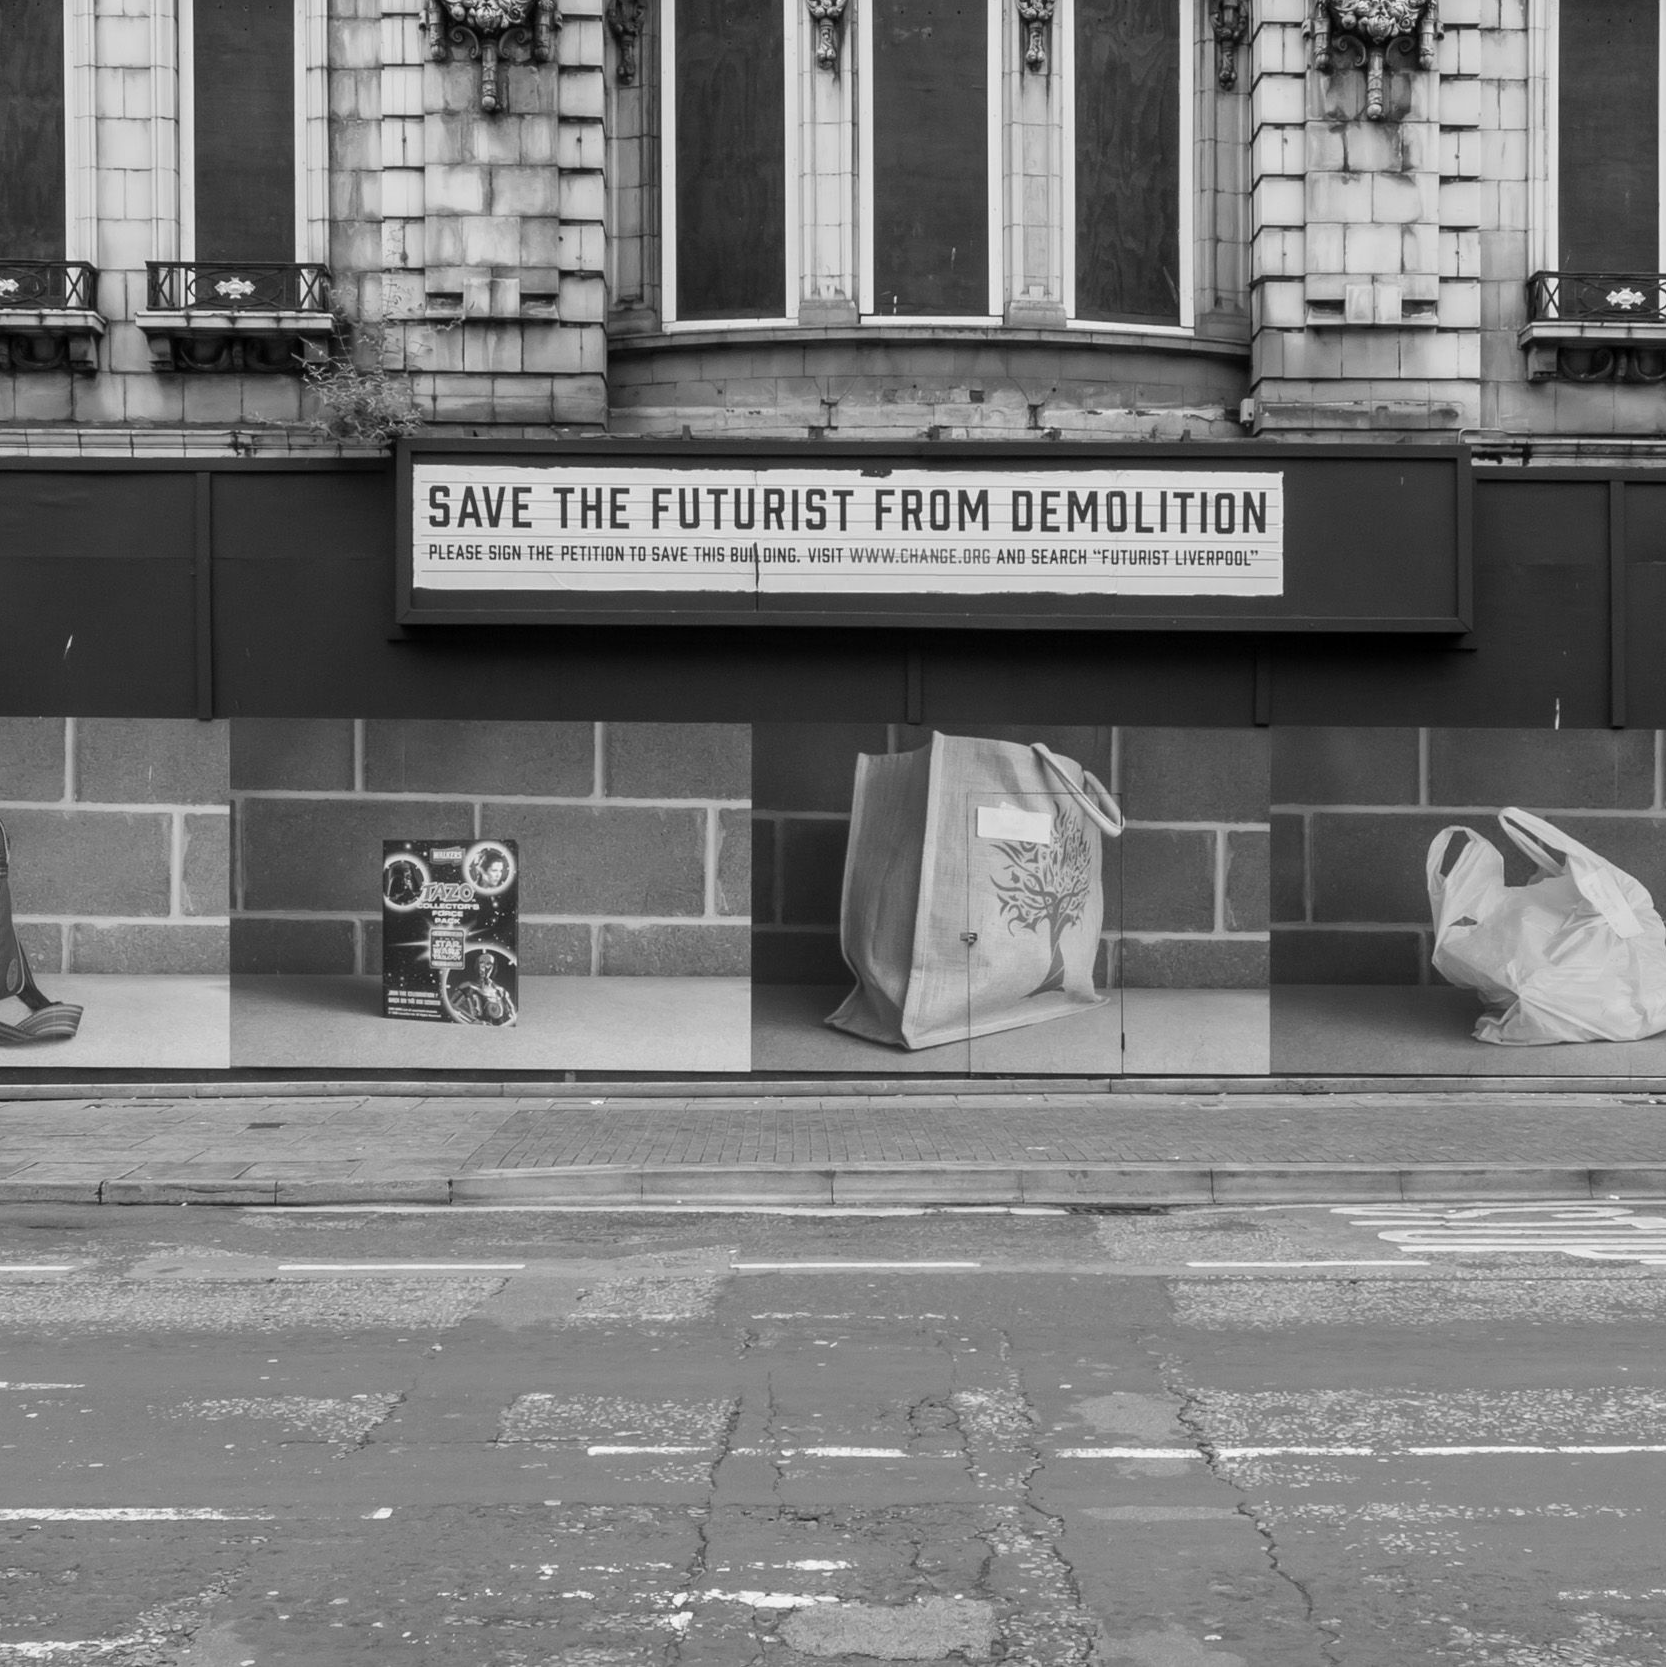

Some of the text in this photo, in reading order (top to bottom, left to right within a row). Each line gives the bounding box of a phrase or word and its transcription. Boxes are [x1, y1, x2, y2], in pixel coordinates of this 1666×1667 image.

[429, 486, 1266, 534] SAVE THE FUTURIST FROM DEMOLITION
[429, 544, 482, 560] PLEASE
[489, 545, 521, 560] SIGN
[527, 546, 553, 561] THE
[561, 546, 624, 561] PETITION
[629, 547, 646, 561] TO
[651, 547, 687, 561] SAVE
[693, 547, 724, 562] THIS
[808, 548, 843, 562] VISIT
[850, 548, 990, 563] WWW.CHANGE.ORG
[997, 549, 1025, 564] AND
[1032, 549, 1086, 564] SEARCH
[422, 882, 474, 902] TAZO
[432, 940, 462, 948] STAR
